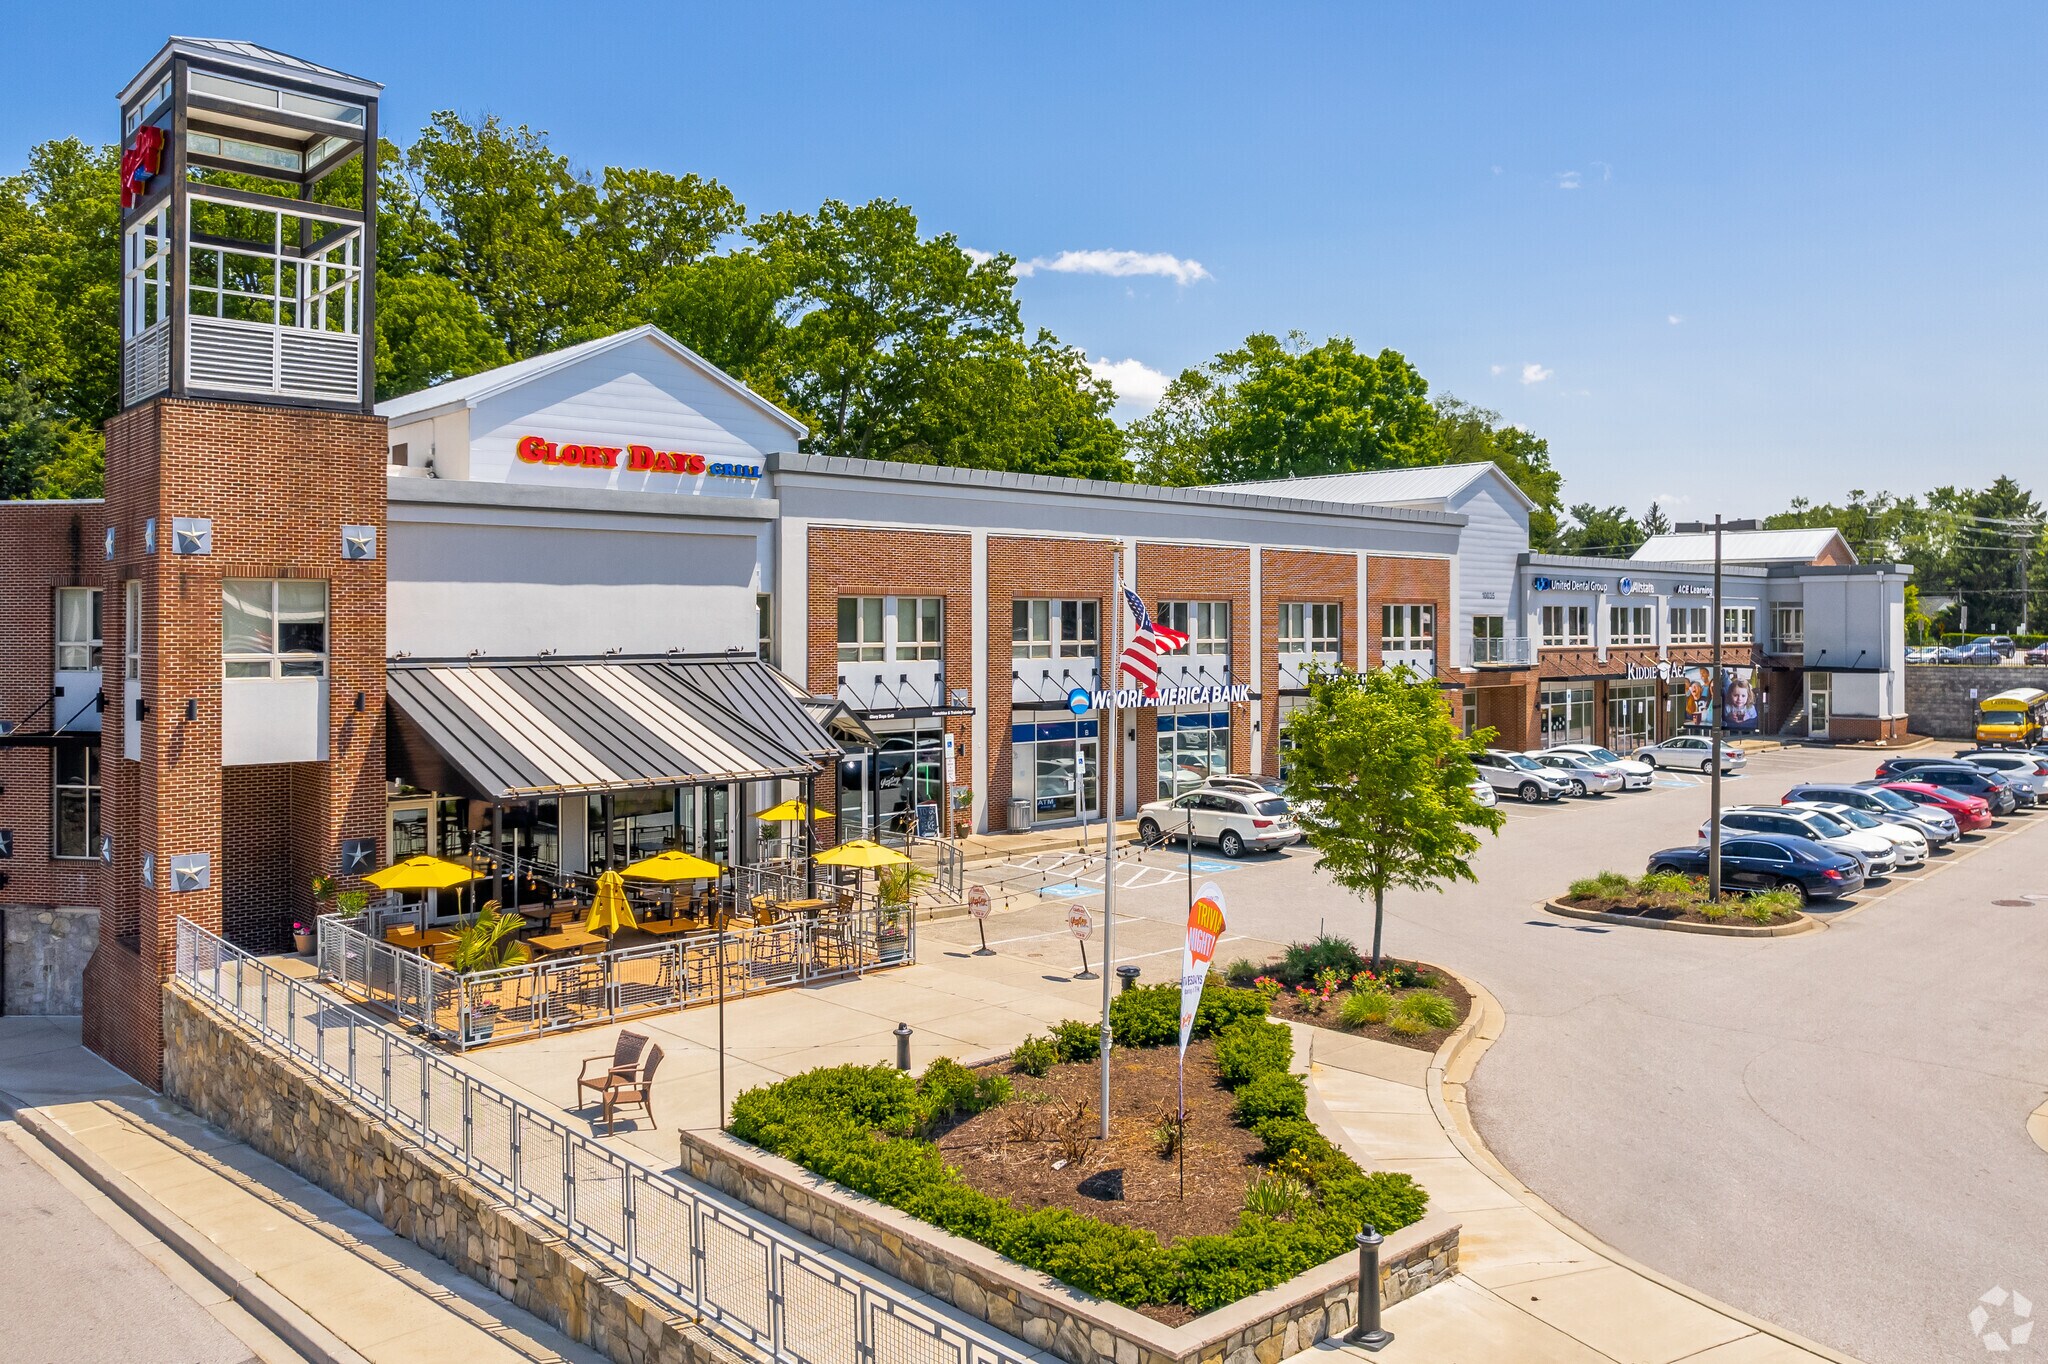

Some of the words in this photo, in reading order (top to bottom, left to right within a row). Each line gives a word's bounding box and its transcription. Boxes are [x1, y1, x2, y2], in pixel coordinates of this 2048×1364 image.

[517, 435, 622, 469] GLORY
[627, 443, 706, 475] DAYS
[707, 462, 762, 480] GRILL
[1551, 580, 1571, 590] United
[1571, 580, 1590, 591] Dental
[1591, 581, 1608, 593] Group
[1632, 582, 1655, 593] Allstate
[1677, 584, 1689, 594] ACE
[1690, 585, 1713, 596] Learning
[1627, 662, 1657, 680] KIDDIE
[1211, 684, 1250, 704] BANK
[1197, 901, 1223, 934] TRIVIA
[1189, 926, 1216, 958] NIGHT!
